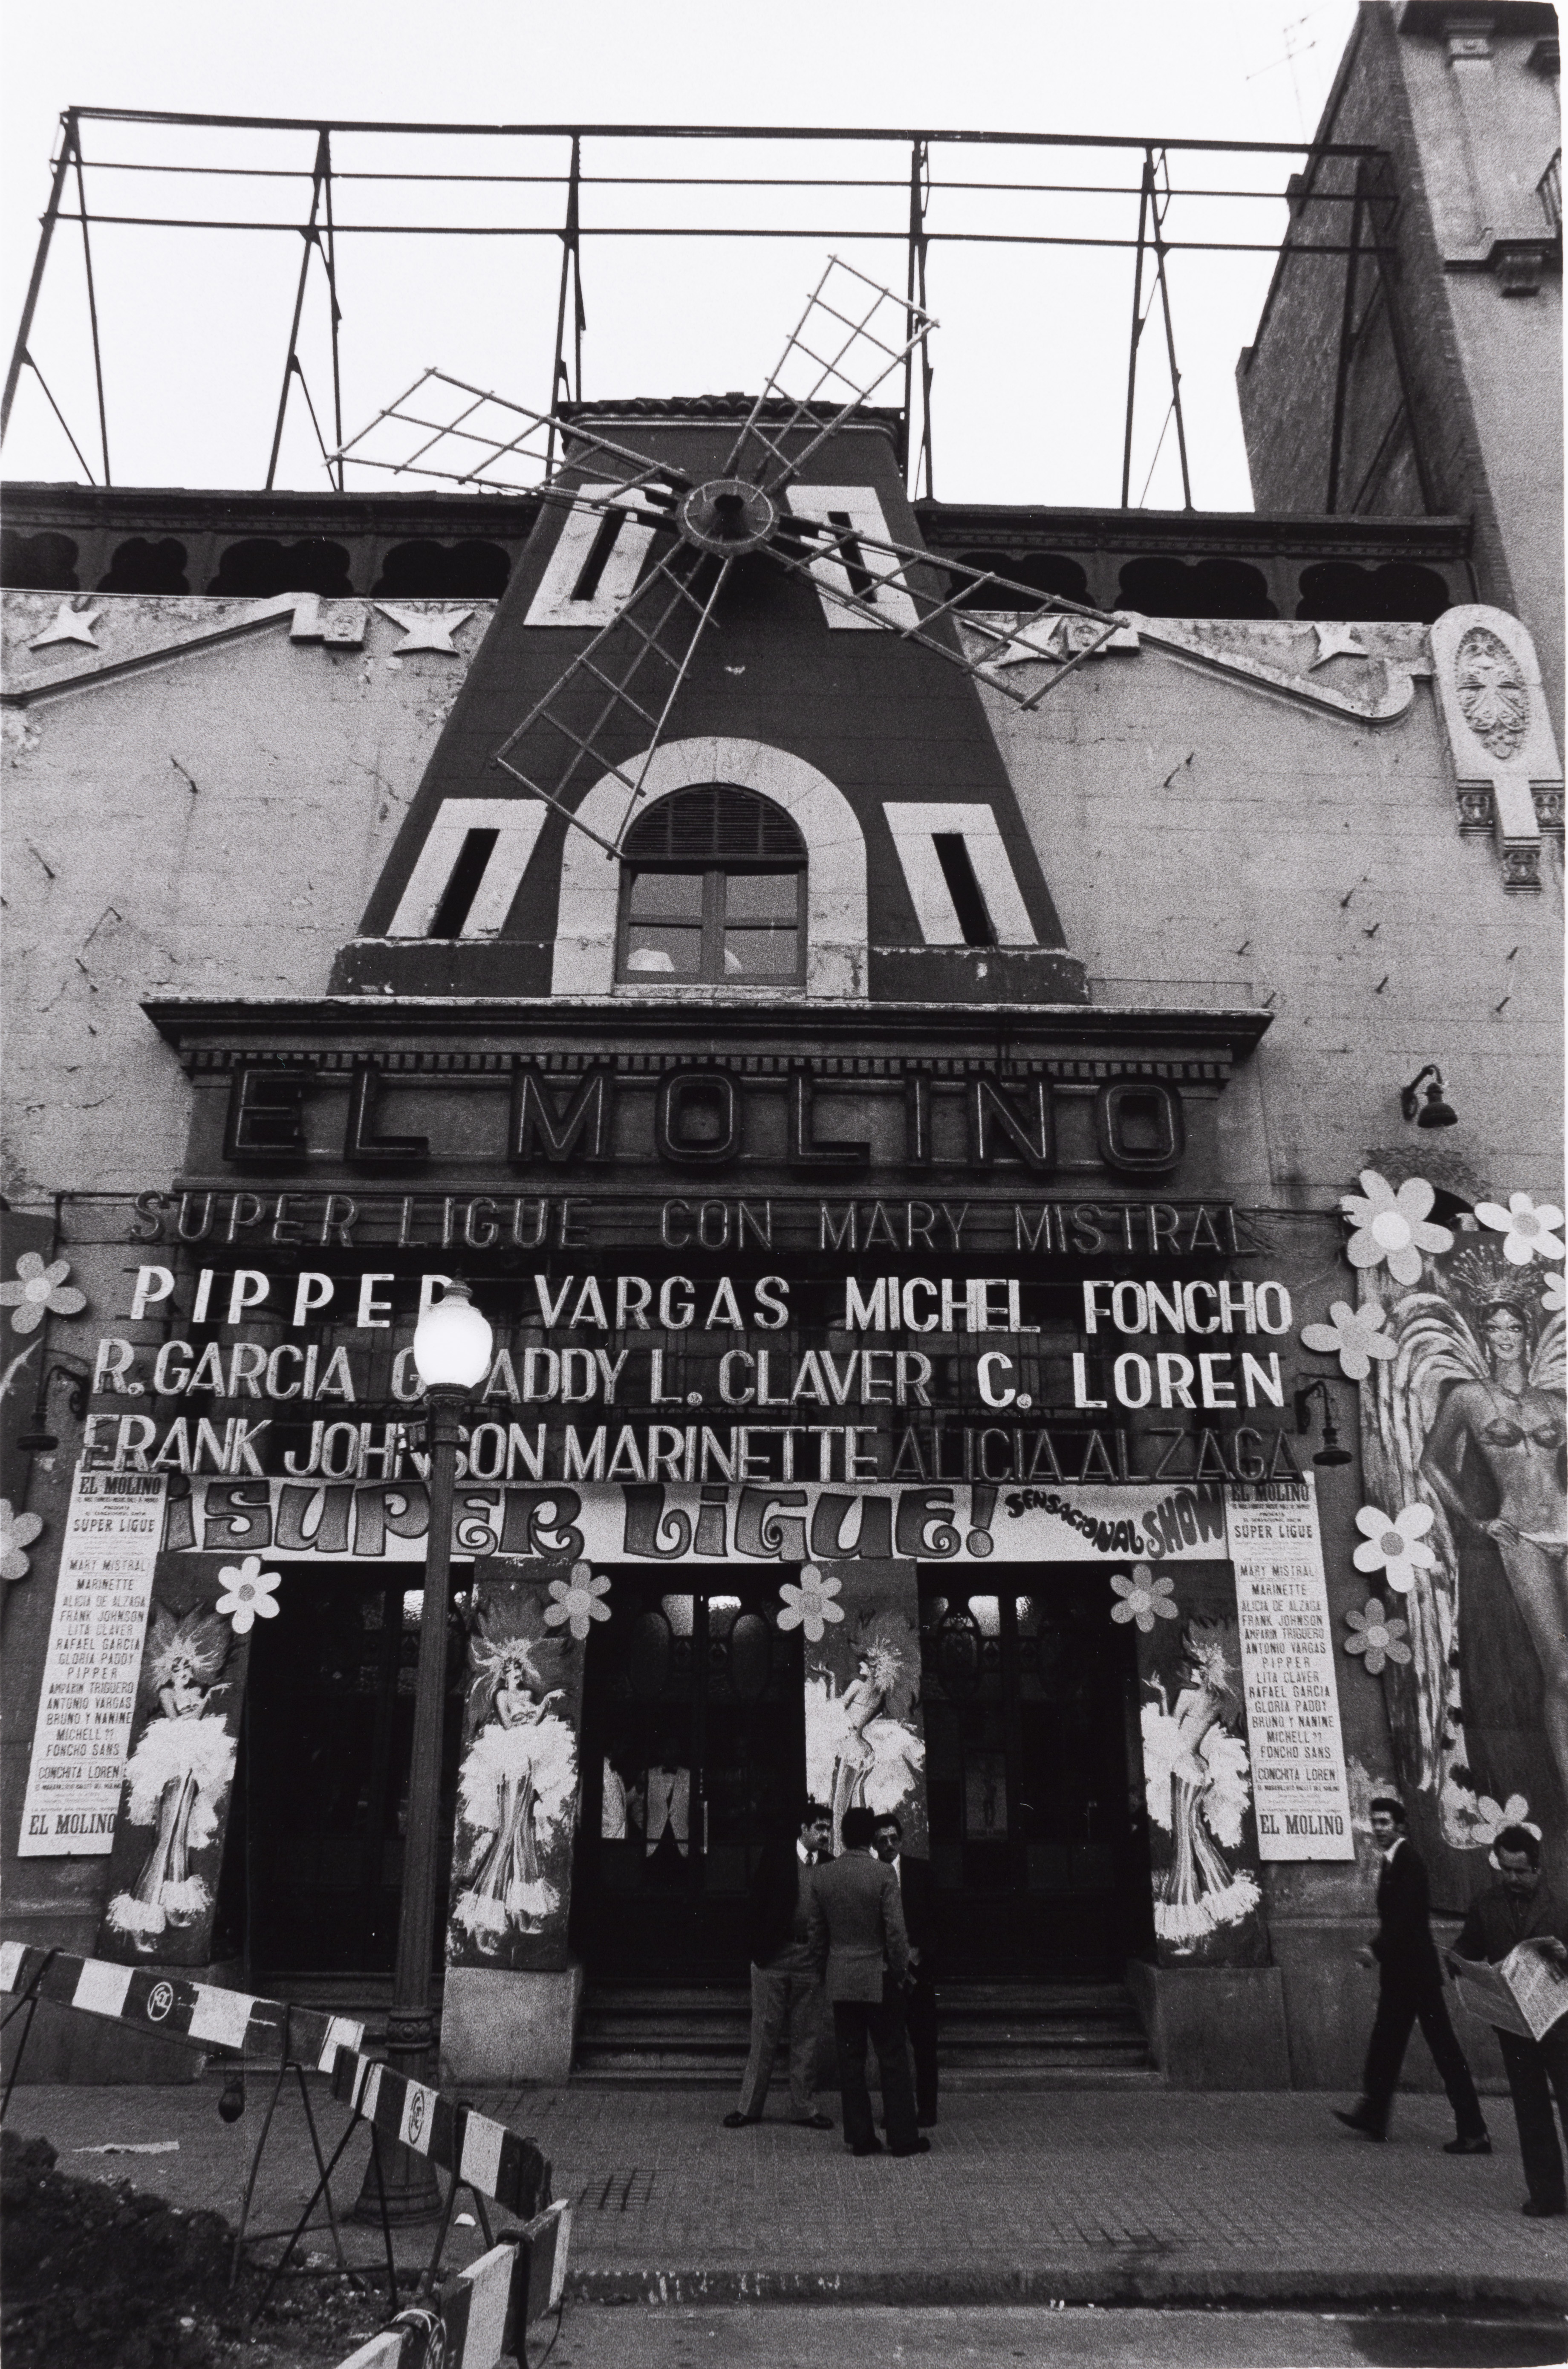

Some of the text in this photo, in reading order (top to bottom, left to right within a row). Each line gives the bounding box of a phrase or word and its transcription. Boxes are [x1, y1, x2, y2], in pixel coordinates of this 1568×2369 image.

[222, 1059, 1187, 1171] EL MOLINO
[130, 1190, 1258, 1257] SUPER LIGUE CON MARY MISTRAL
[534, 1274, 790, 1330] VARGAS
[845, 1276, 1040, 1333] MICHEL
[1083, 1280, 1292, 1335] FONCHO
[468, 1347, 629, 1404] ADDY
[977, 1352, 1032, 1409] C.
[1072, 1352, 1284, 1408] LOREN
[563, 1424, 878, 1483] MARINETTE
[890, 1425, 1066, 1485] ALICIA
[1077, 1426, 1307, 1485] ALZAGA
[79, 1476, 162, 1495] EL MOLINO
[1232, 1482, 1309, 1502] EL MOLINO
[74, 1519, 155, 1532] SUPER LIGUE
[1142, 1484, 1223, 1559] SHOW
[1234, 1525, 1313, 1538] SUPER LIGUE
[69, 1560, 146, 1571] MARY MISTRAL
[1240, 1565, 1314, 1577] MARY MISTRAL
[76, 1578, 134, 1591] MARINETTE
[1252, 1583, 1306, 1595] MARINETTE
[60, 1610, 144, 1622] FRANK JOHNSON
[1241, 1615, 1323, 1627] FRANK JOHNSON
[55, 1638, 140, 1650] RAFAEL GARCIA
[1246, 1642, 1326, 1654] ANTONIO VARGAS
[58, 1653, 95, 1665] GLORIA
[1262, 1656, 1311, 1669] PIPPER
[67, 1667, 117, 1679] PIPPER
[1257, 1670, 1320, 1684] LITA CLAVER
[1249, 1685, 1331, 1698] RAFAEL GARCIA
[47, 1696, 131, 1709] ANTONIO VARGAS
[1255, 1700, 1290, 1713] GLORIA
[46, 1713, 81, 1725] BRUNO
[86, 1713, 91, 1725] Y
[1252, 1716, 1284, 1728] BRUNO
[1288, 1716, 1294, 1728] Y
[1267, 1731, 1310, 1743] MICHELL
[46, 1743, 120, 1757] FONCHO SANS
[1261, 1745, 1331, 1759] FONCHO SANS
[38, 1765, 119, 1779] CONCHITA LOREN
[1258, 1768, 1336, 1781] CONCHITA LOREN
[29, 1813, 116, 1835] EL MOLINO
[1259, 1814, 1344, 1835] EL MOLINO
